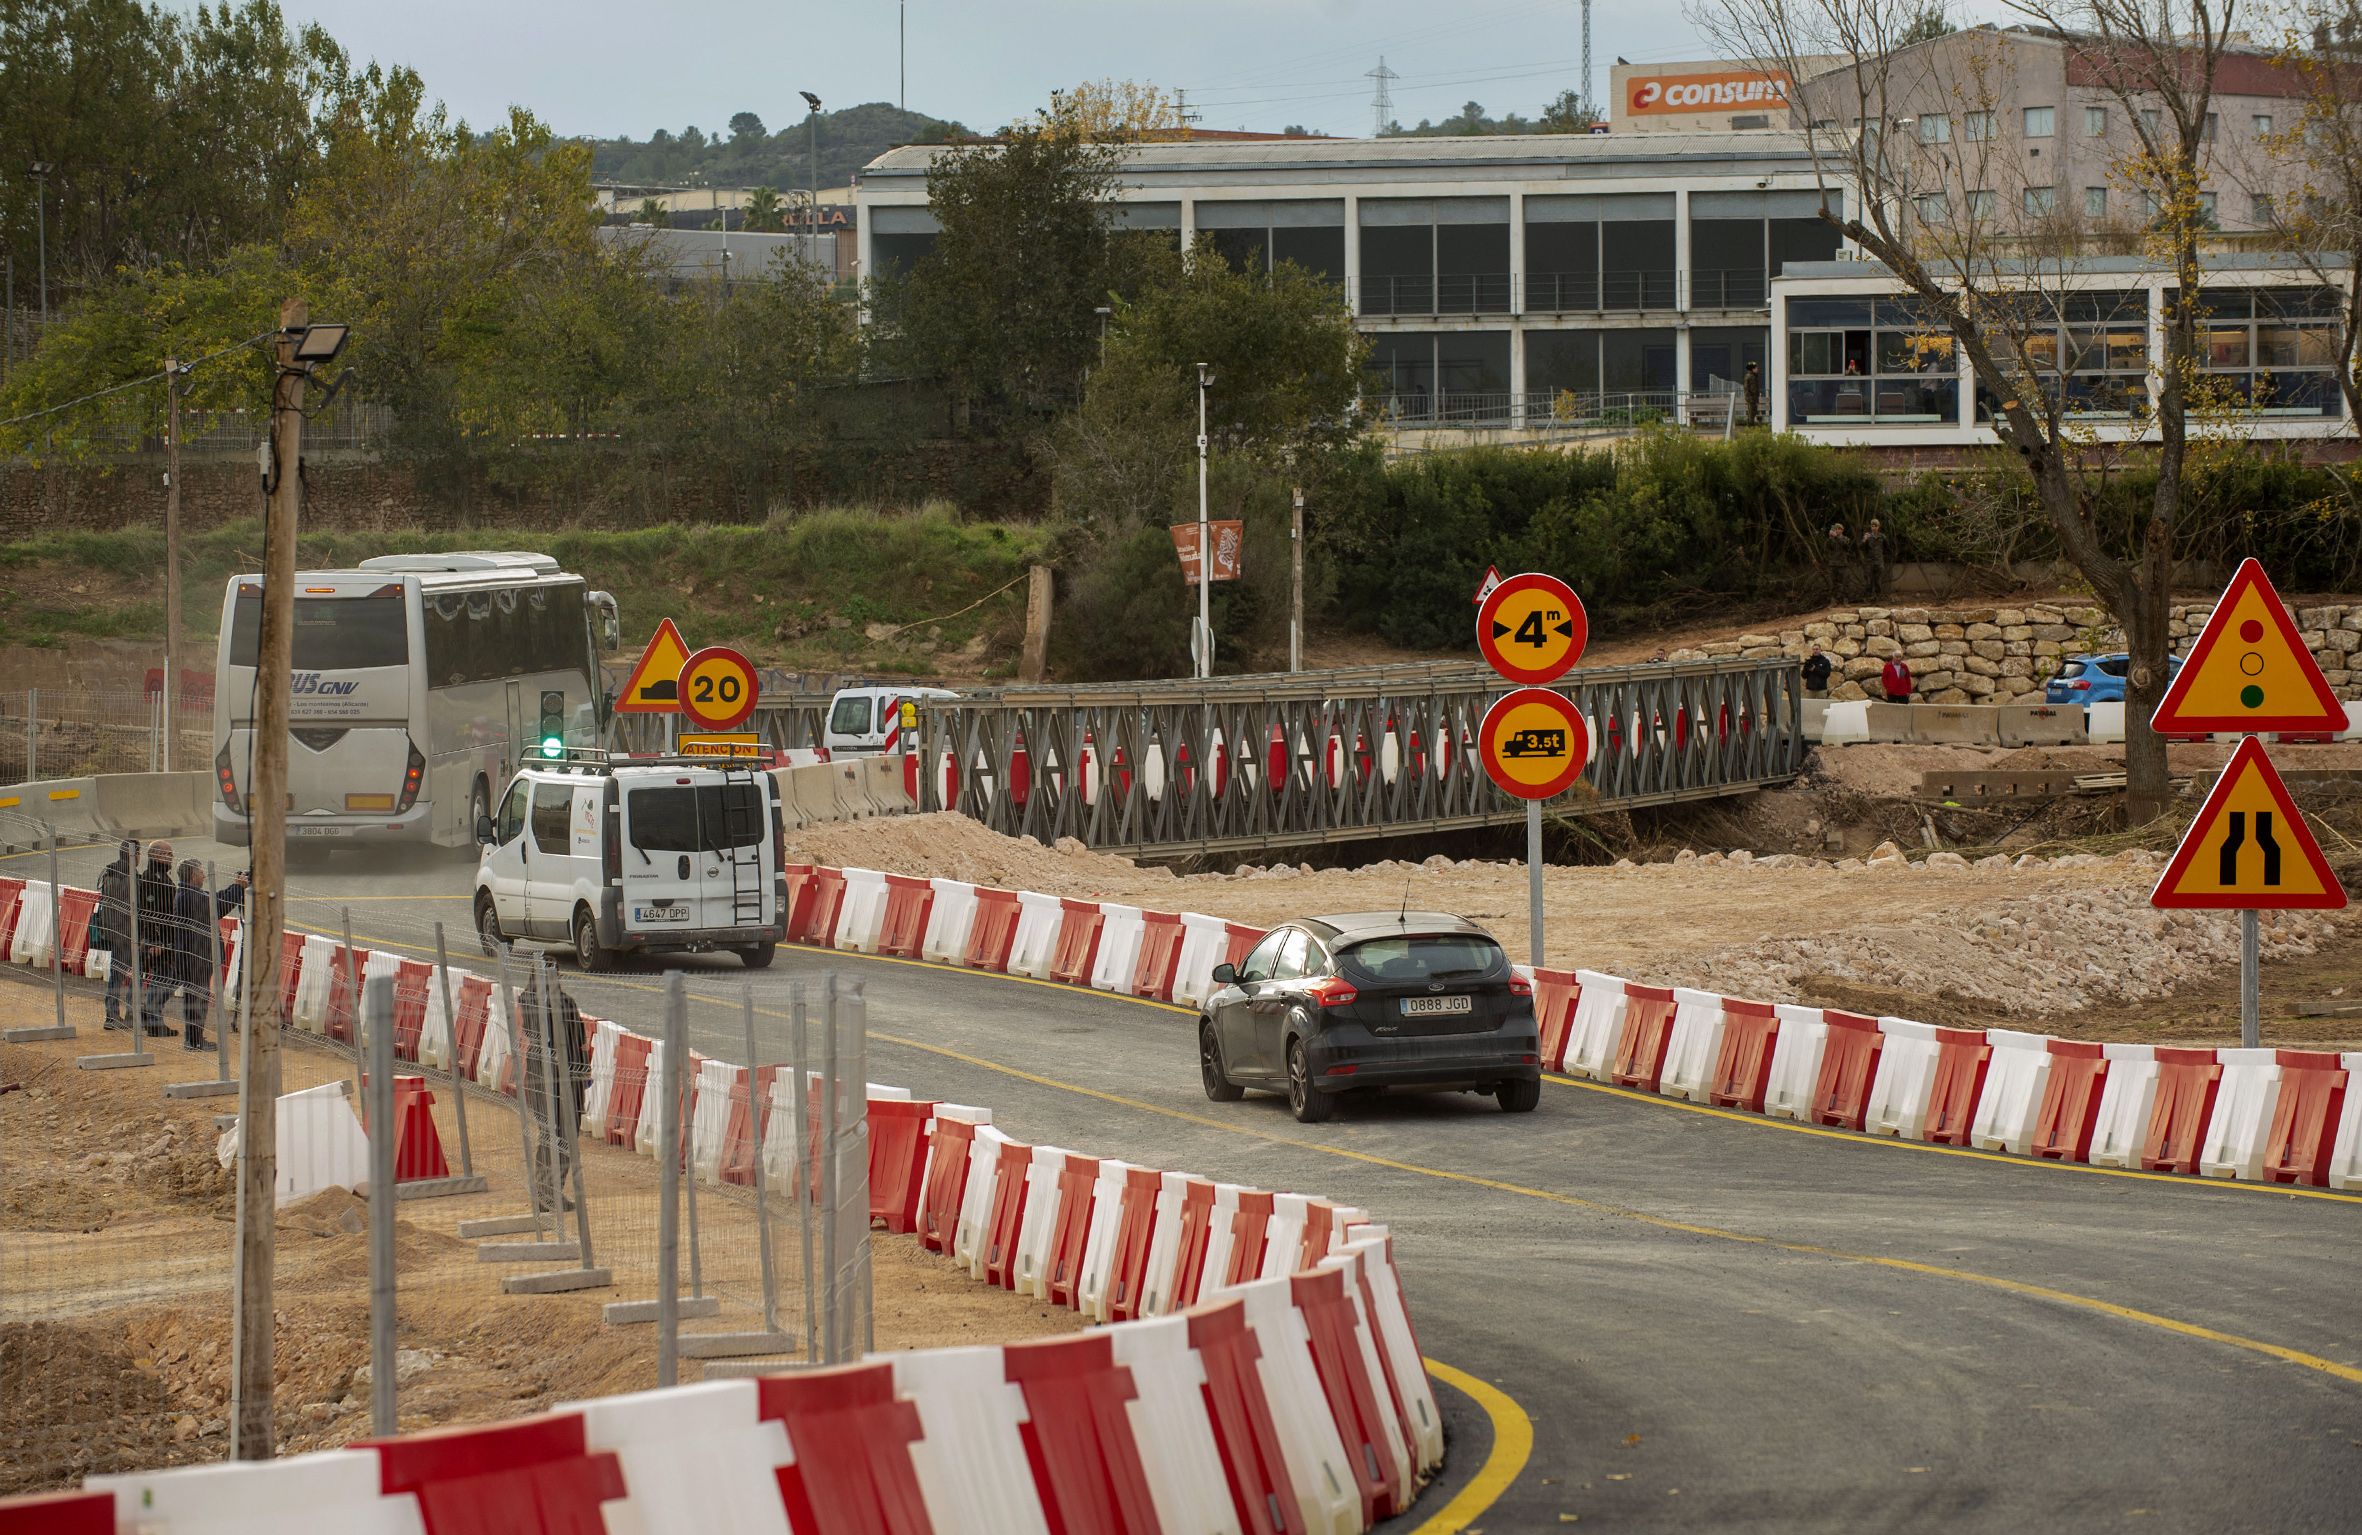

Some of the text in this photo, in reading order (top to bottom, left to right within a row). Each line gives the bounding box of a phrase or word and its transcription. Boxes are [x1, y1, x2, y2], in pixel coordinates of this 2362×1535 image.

[1665, 80, 1787, 106] consum
[317, 681, 360, 695] GNV
[693, 675, 741, 703] 20
[643, 908, 687, 919] 4647 DPP
[1410, 998, 1469, 1011] 0888 JGD
